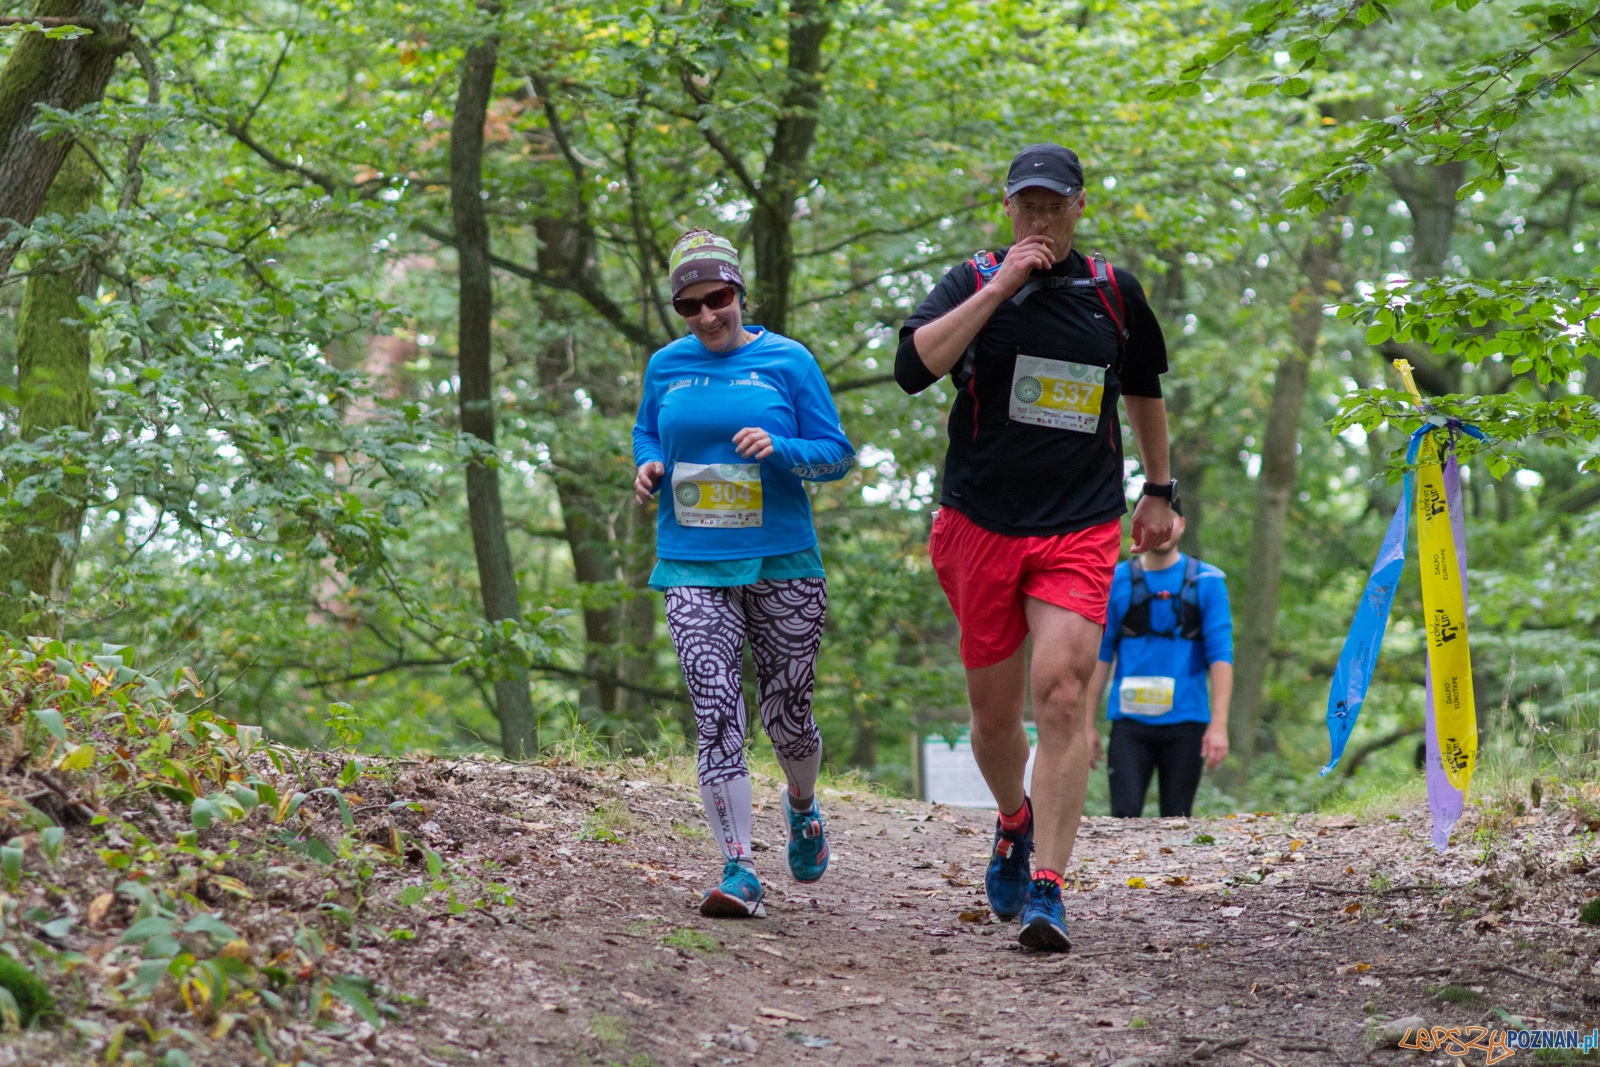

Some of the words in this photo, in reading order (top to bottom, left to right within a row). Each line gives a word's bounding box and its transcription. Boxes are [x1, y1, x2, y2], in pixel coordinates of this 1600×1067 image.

[1052, 381, 1094, 406] 537
[710, 483, 752, 503] 304
[1452, 676, 1460, 709] EUROTAPE
